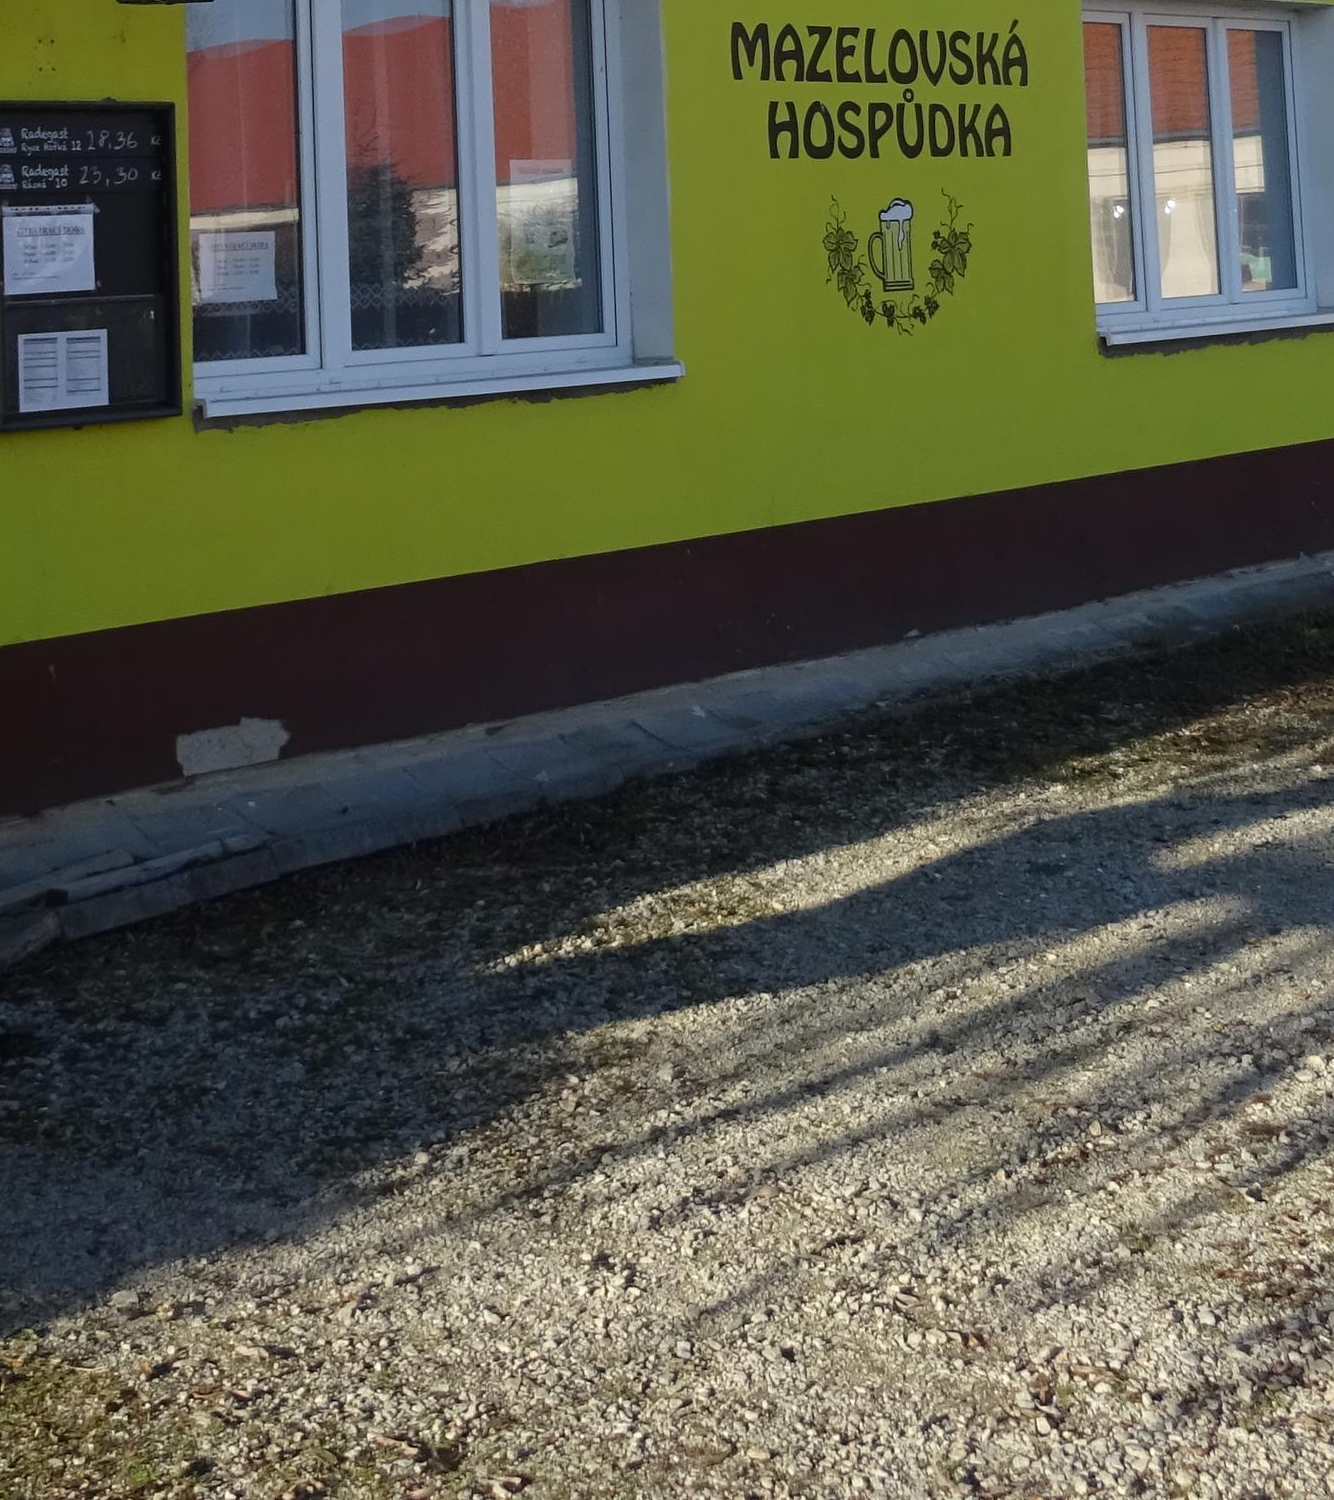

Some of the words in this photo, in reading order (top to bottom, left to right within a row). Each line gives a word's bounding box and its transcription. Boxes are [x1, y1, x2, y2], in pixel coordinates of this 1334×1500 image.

[730, 19, 1028, 87] MAZELOVSKÁ
[768, 88, 1012, 160] HOSPŮDKA
[21, 127, 69, 143] Radegast
[71, 140, 82, 152] 12
[21, 164, 69, 180] Radegast
[55, 178, 68, 189] 10
